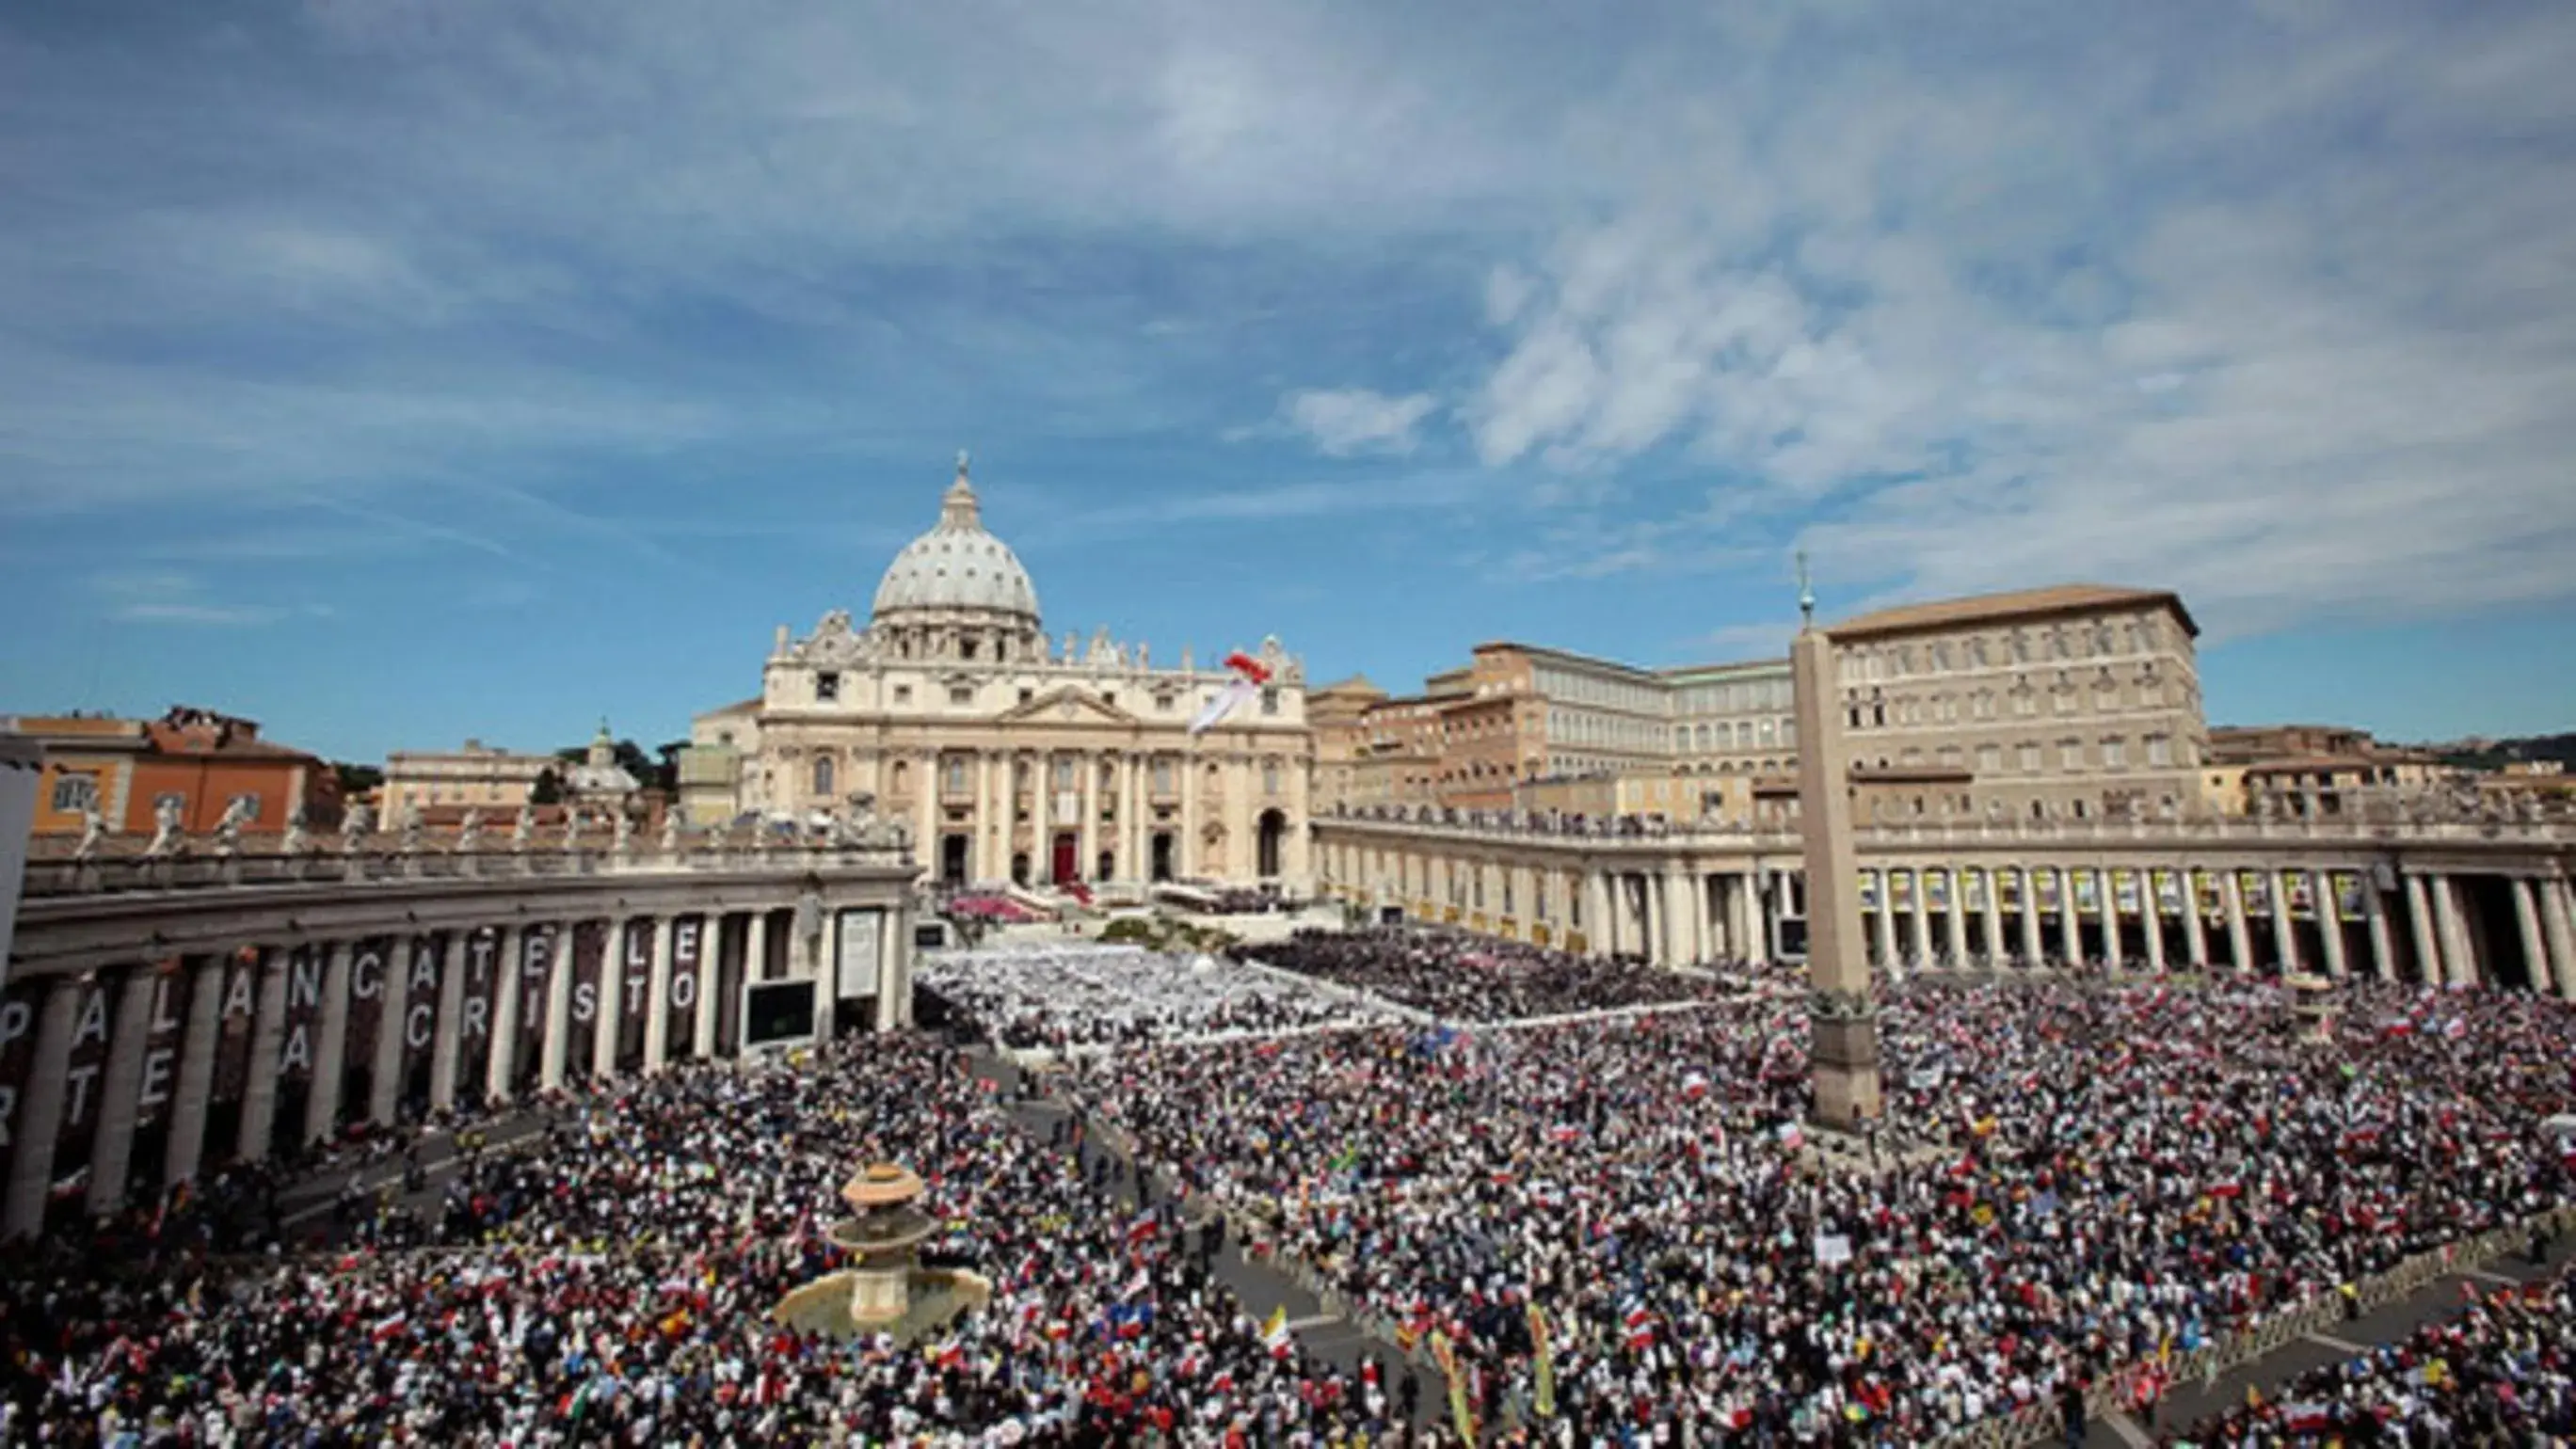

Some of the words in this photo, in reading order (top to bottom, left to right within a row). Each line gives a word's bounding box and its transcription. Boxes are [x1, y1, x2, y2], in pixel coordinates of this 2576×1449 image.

[627, 924, 697, 966] LE
[280, 1025, 312, 1076] A
[406, 973, 696, 1048] CRISTO
